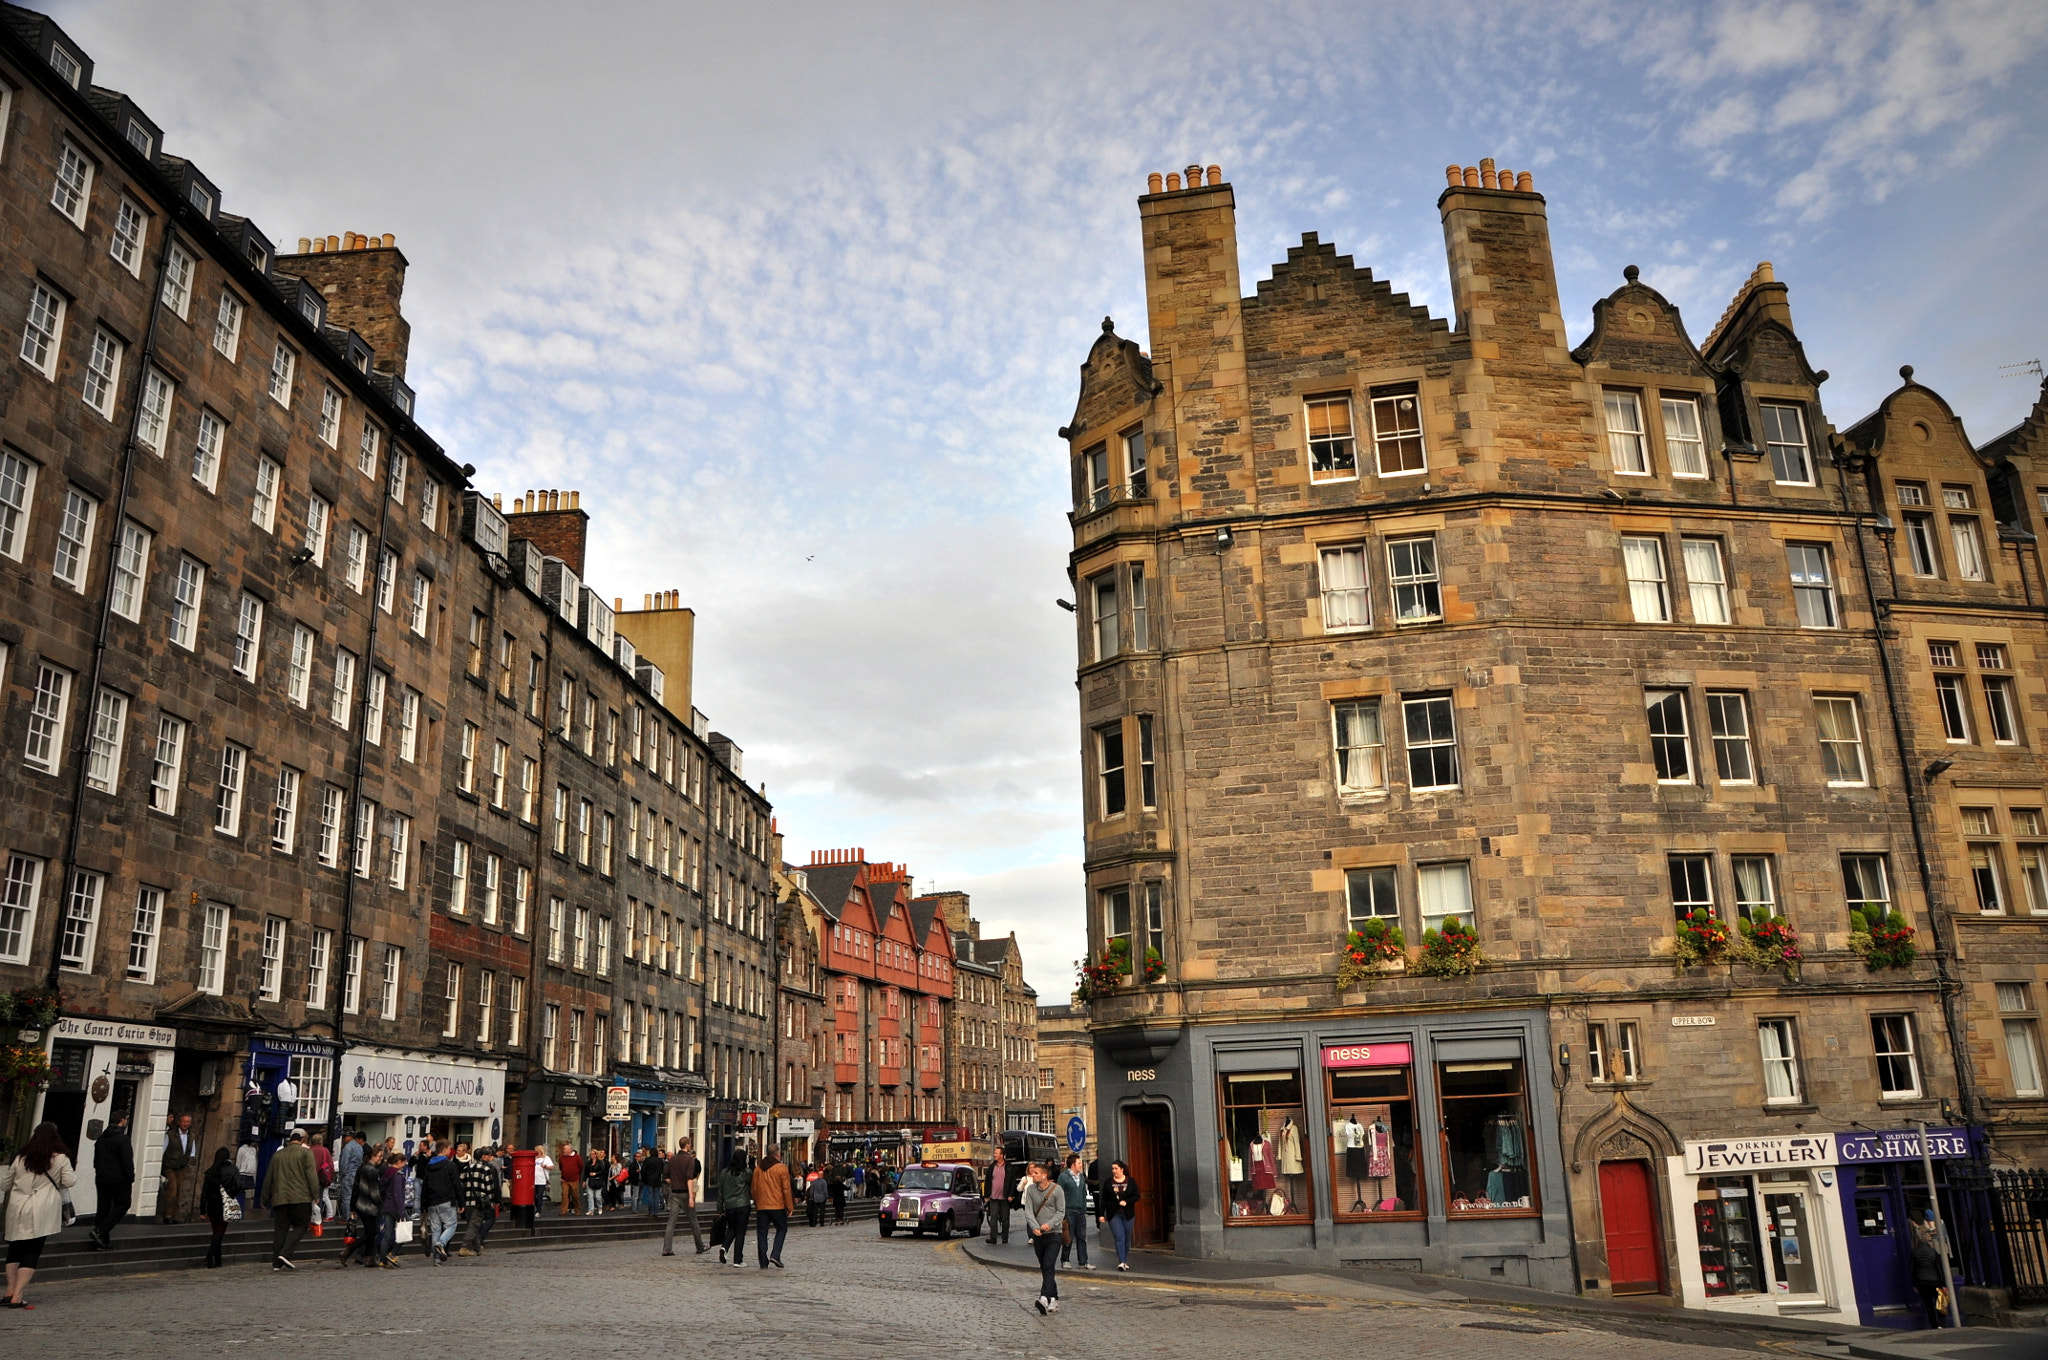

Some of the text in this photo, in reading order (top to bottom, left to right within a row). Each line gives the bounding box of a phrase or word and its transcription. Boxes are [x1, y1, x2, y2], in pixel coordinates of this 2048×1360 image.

[59, 1019, 172, 1044] The Court Curio Shop
[265, 1040, 280, 1050] WEE
[281, 1041, 321, 1054] SCOTLAND
[1331, 1047, 1370, 1061] ness
[1127, 1069, 1156, 1081] ness
[368, 1071, 475, 1096] HOUSE OF SCOTLAND
[352, 1093, 370, 1102] Scottish
[388, 1095, 409, 1104] Cashmere
[1736, 1140, 1783, 1150] ORKNEY
[1842, 1137, 1967, 1160] CASHMERE
[1696, 1139, 1828, 1170] JEWELLERY
